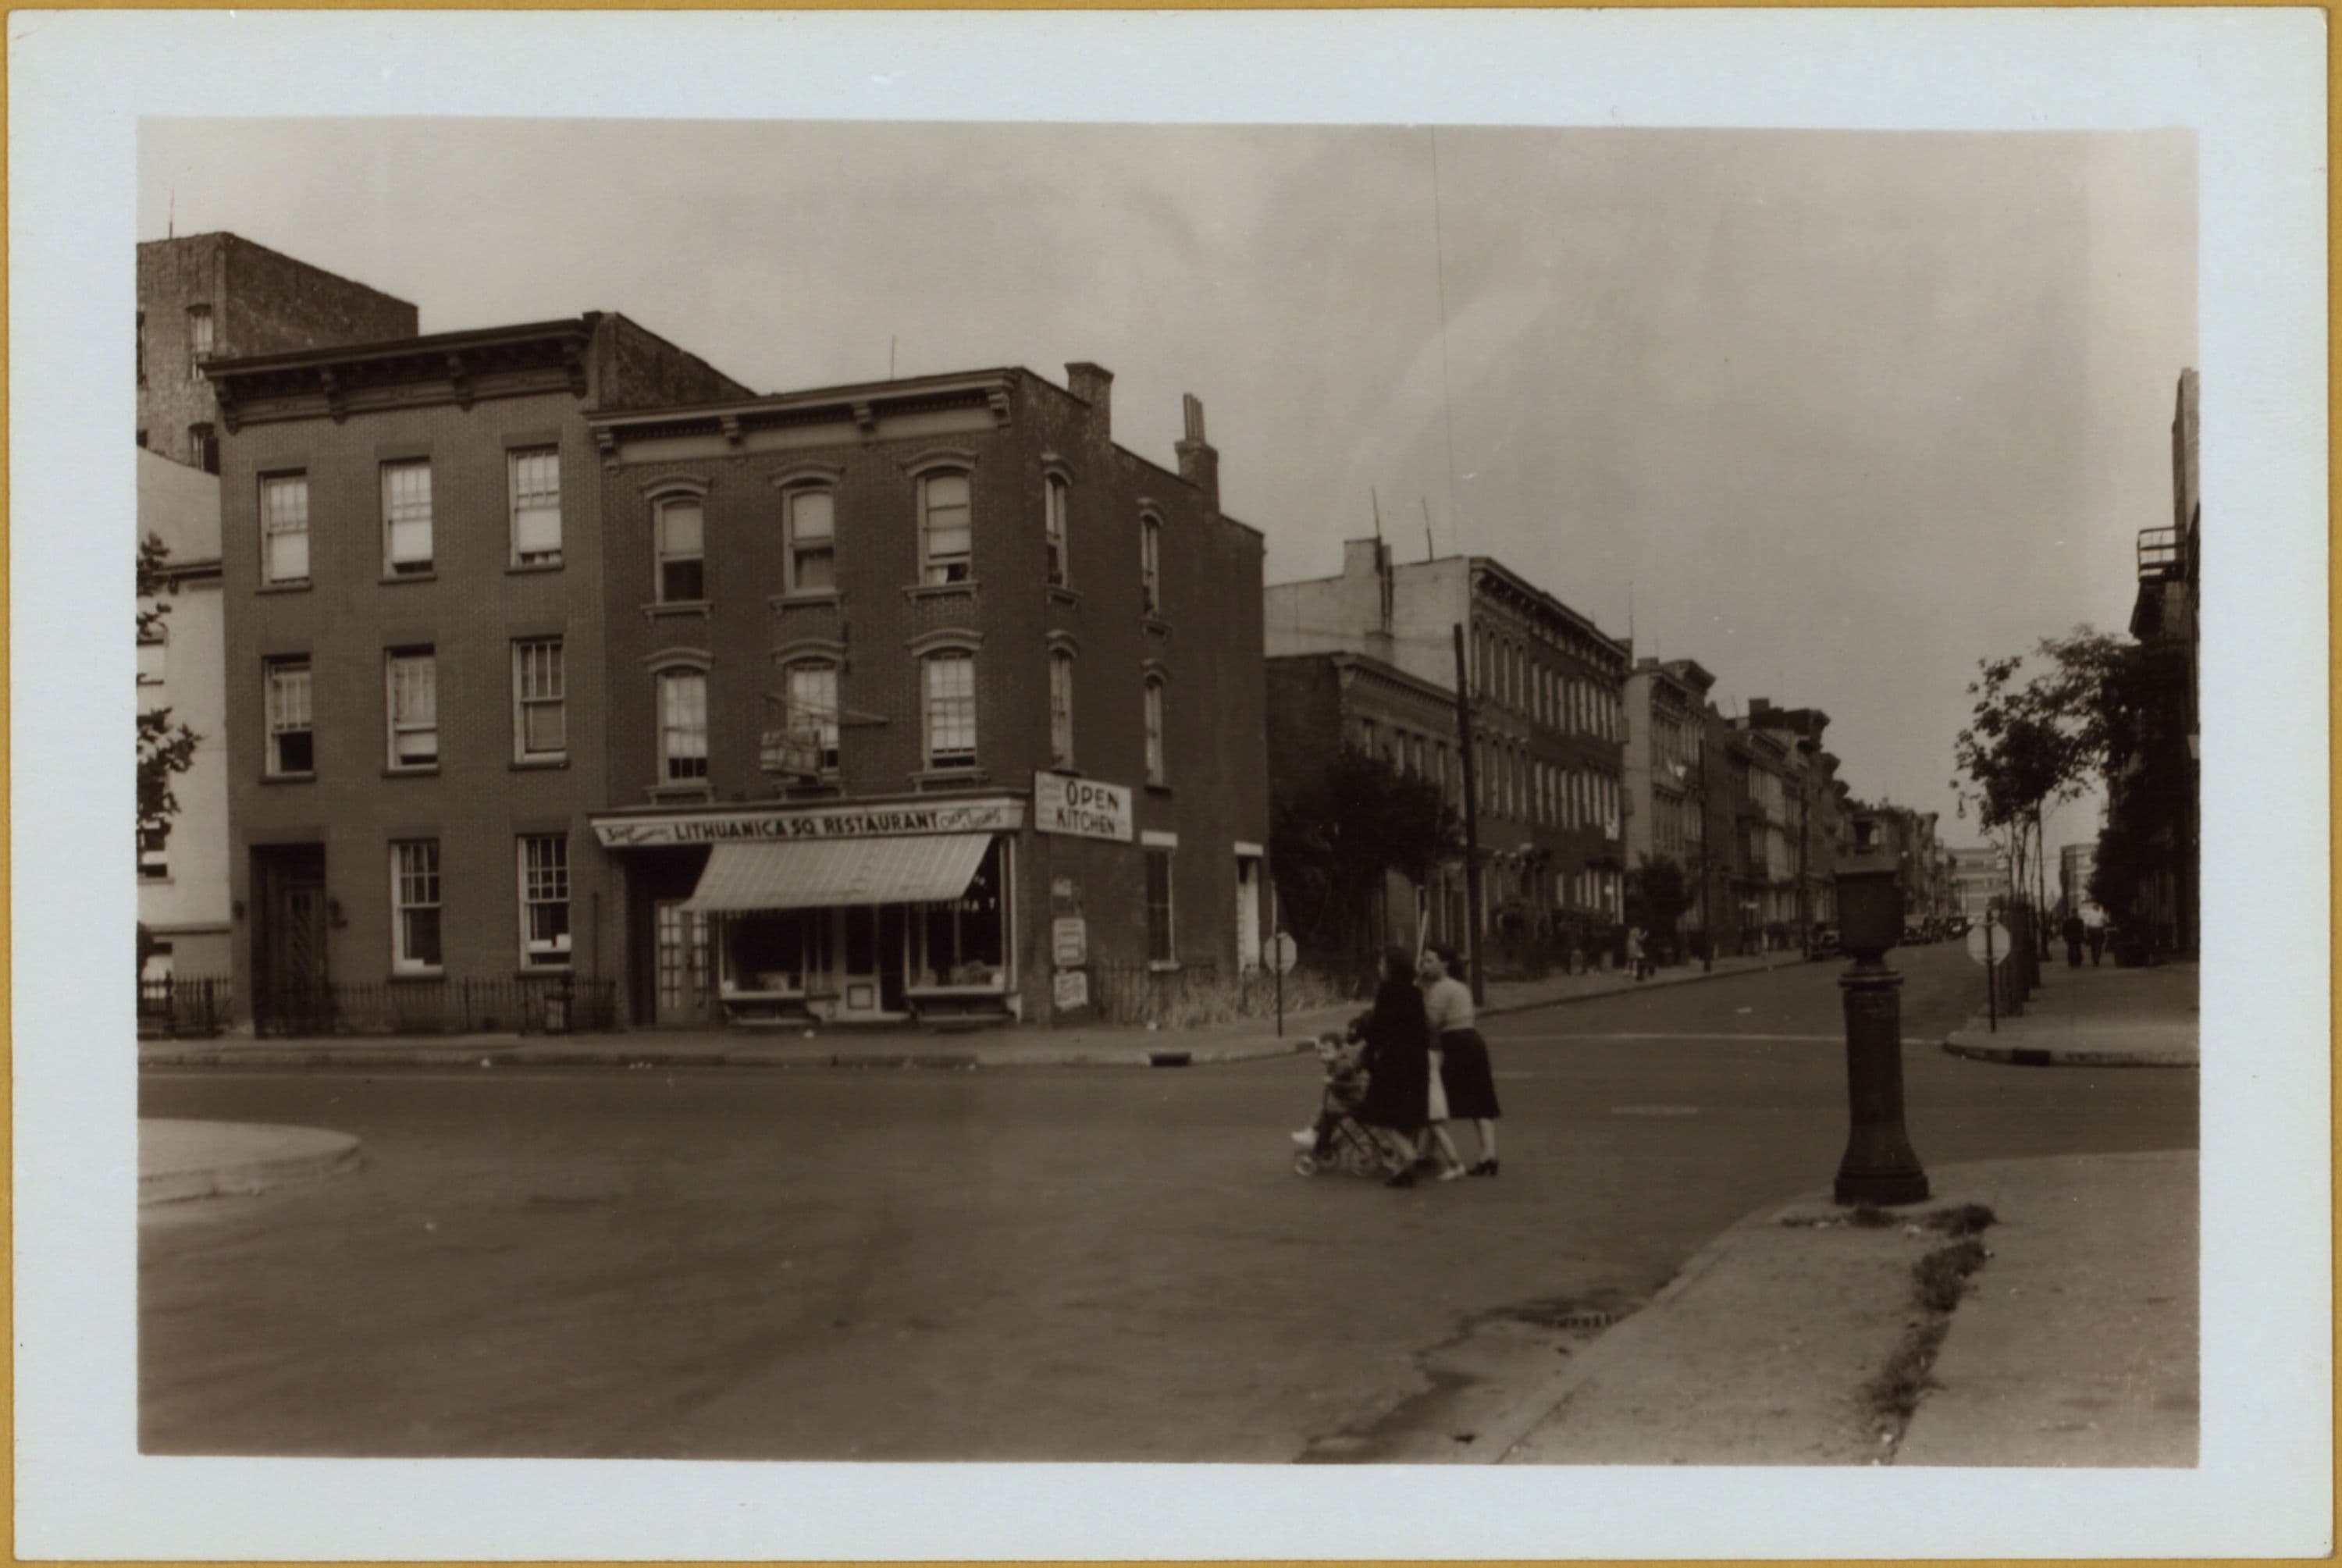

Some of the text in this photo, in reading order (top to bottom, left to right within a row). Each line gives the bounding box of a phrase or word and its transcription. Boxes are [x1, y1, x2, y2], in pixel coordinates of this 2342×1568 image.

[1066, 780, 1119, 812] OPEN
[674, 820, 787, 840] LITHUANICA
[824, 812, 937, 834] RESTAURANT
[1056, 807, 1116, 834] KITCHEN
